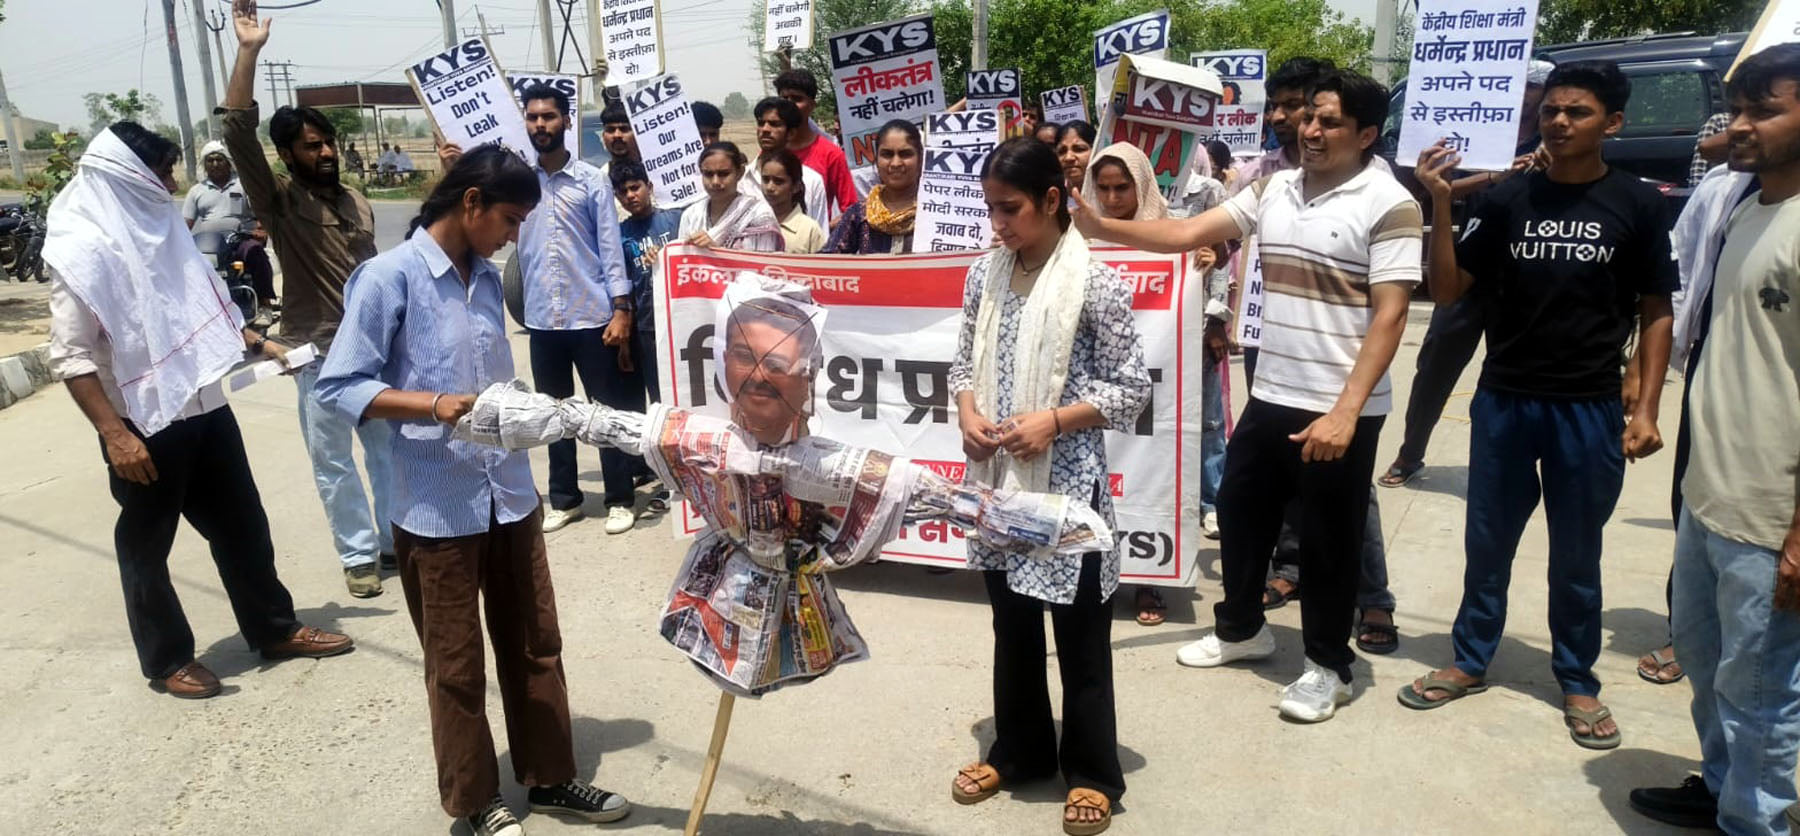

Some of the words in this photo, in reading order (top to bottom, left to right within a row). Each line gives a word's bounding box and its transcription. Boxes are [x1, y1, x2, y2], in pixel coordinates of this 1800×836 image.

[629, 6, 654, 22] प्रधान
[775, 16, 802, 30] अबकी
[1422, 11, 1458, 31] केंद्रीय
[1459, 10, 1494, 29] शिक्षा
[1497, 7, 1526, 28] मंत्री
[609, 28, 633, 43] अपने
[636, 27, 651, 37] पद
[836, 21, 929, 61] KYS
[1098, 19, 1161, 60] KYS
[412, 39, 487, 83] KYS
[608, 49, 616, 61] से
[1415, 35, 1470, 64] धर्मेन्द्र
[1472, 39, 1528, 62] प्रधान
[625, 62, 639, 75] दो!
[1197, 56, 1260, 76] KYS
[427, 65, 496, 105] Listen!
[840, 58, 934, 98] लीकतंत्र
[968, 69, 1016, 94] KYS
[1421, 71, 1474, 92] अपने
[1478, 76, 1513, 93] पद
[451, 91, 492, 119] Don't
[626, 75, 682, 114] KYS
[849, 96, 879, 119] नहीं
[880, 89, 934, 113] चलेगा!
[1043, 86, 1079, 107] KYS
[1133, 77, 1210, 117] KYS
[633, 102, 690, 135] Listen!
[929, 110, 997, 133] KYS
[1228, 109, 1258, 128] लीक
[1410, 101, 1430, 121] से
[1433, 101, 1514, 126] इस्तीफ़ा
[465, 113, 499, 138] Leak
[1223, 128, 1256, 146] चलेगा
[658, 130, 677, 146] Our
[644, 146, 683, 172] Dreams
[685, 140, 703, 155] Are
[924, 150, 983, 174] KY
[661, 171, 679, 186] Not
[681, 163, 696, 177] for
[671, 181, 697, 202] Sale!
[923, 181, 952, 196] पेपर
[953, 185, 984, 200] लीक
[923, 199, 951, 215] मोदी
[954, 205, 992, 219] सरका
[935, 222, 966, 237] जवाब
[968, 222, 984, 241] दो,
[1524, 219, 1602, 240] LOUIS
[1510, 241, 1615, 264] VUITTON
